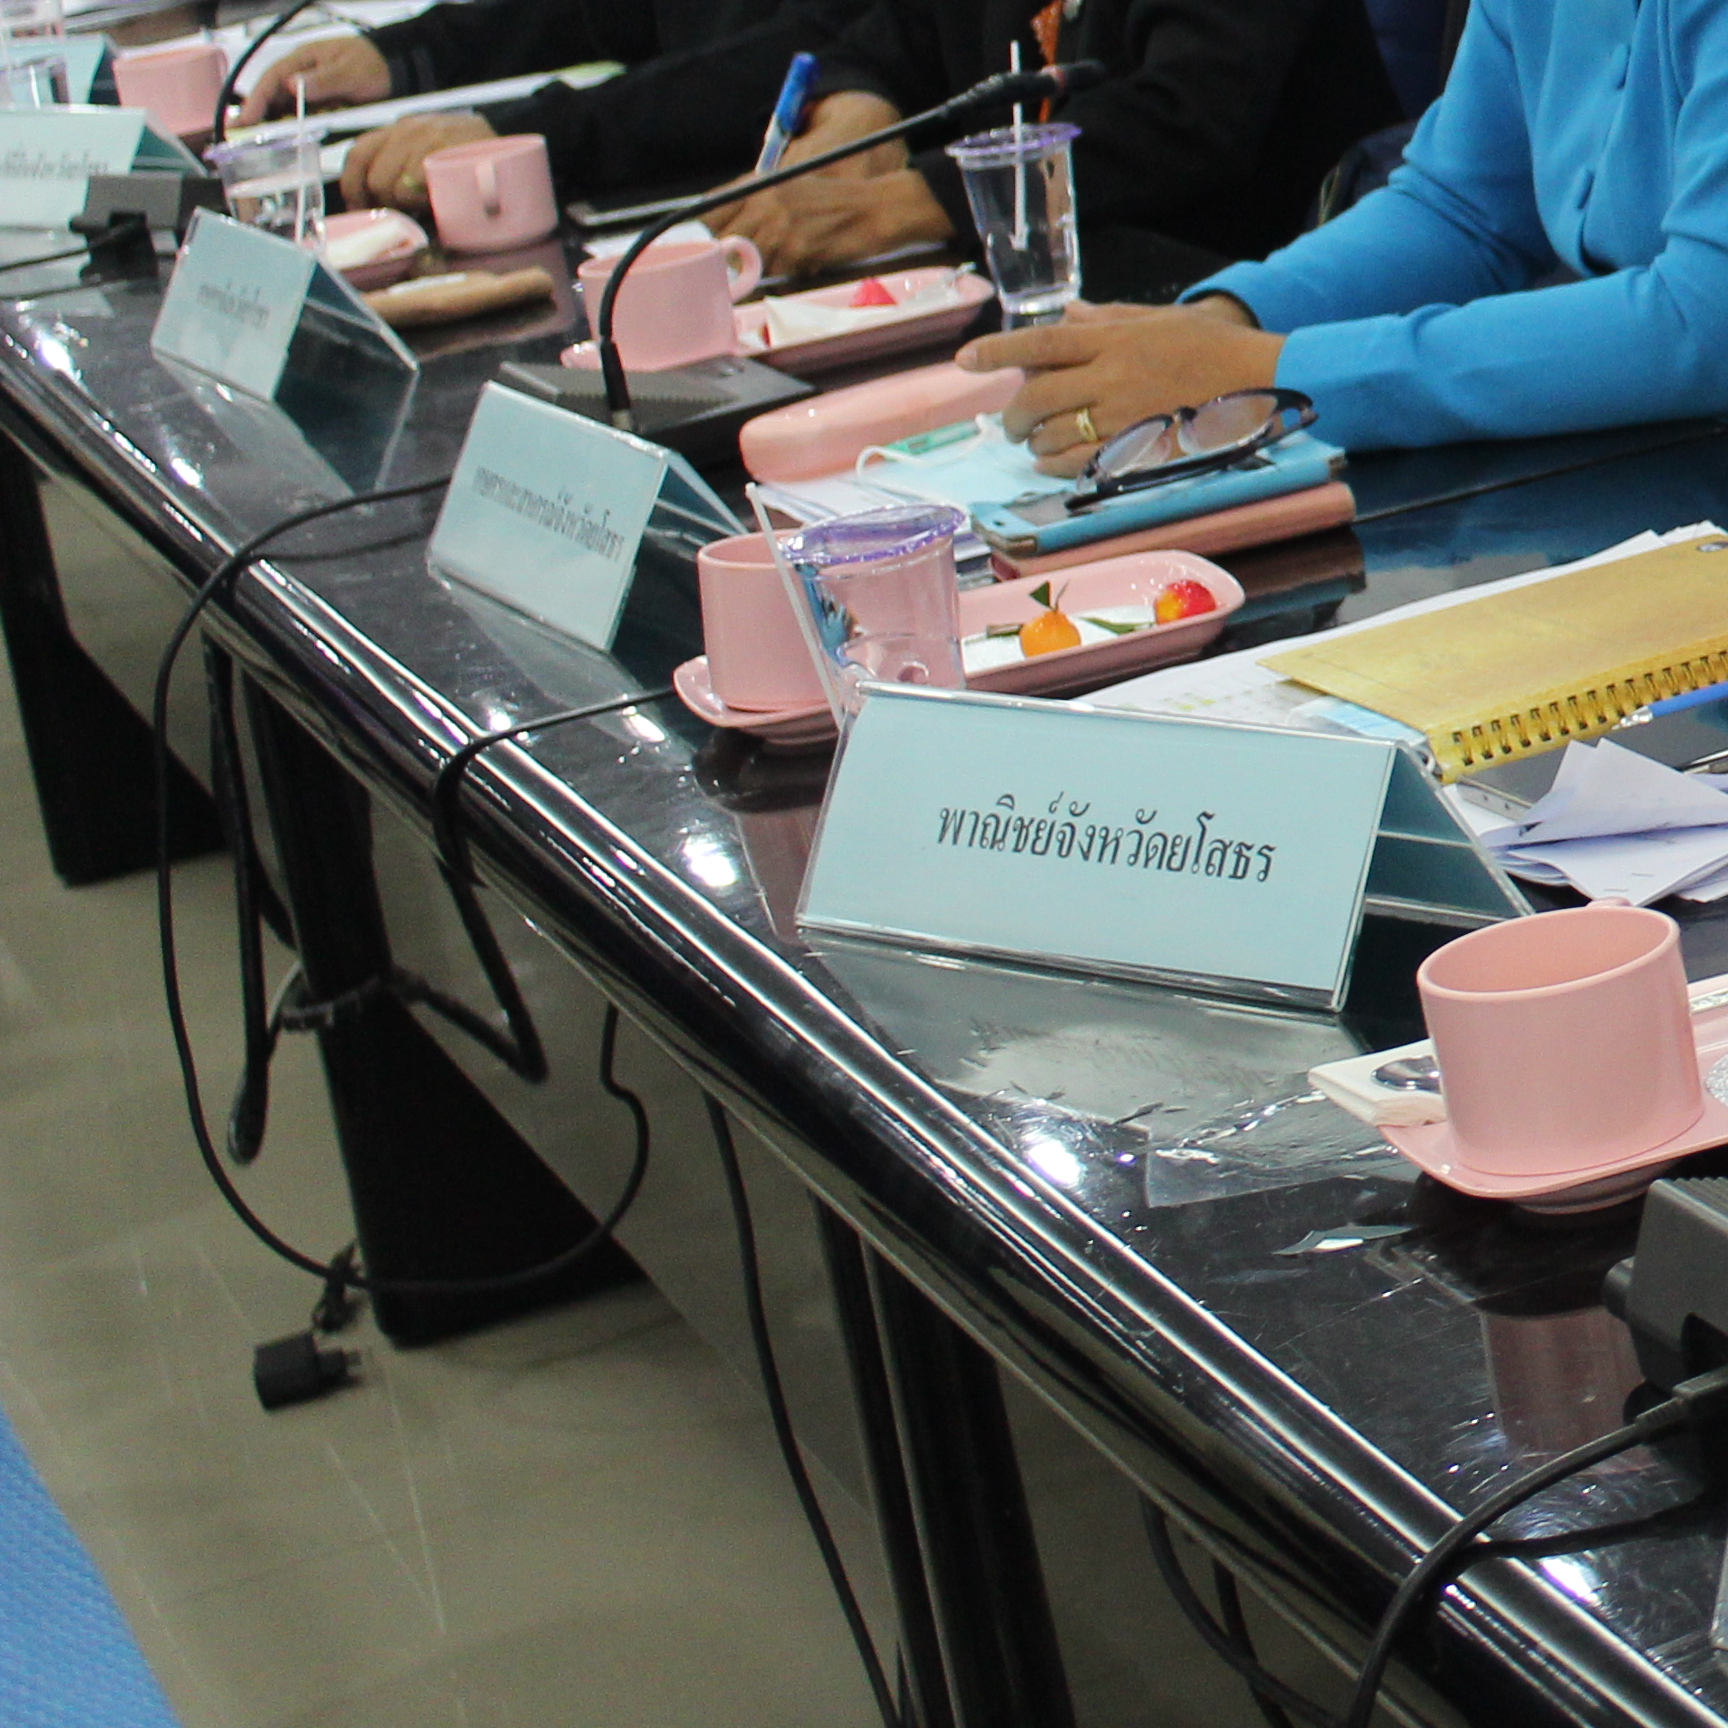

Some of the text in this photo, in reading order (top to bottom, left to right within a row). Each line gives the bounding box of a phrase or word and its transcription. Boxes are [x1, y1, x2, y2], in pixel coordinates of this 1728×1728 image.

[938, 791, 1277, 883] พาณิชย์จังหวัดยโสธร
